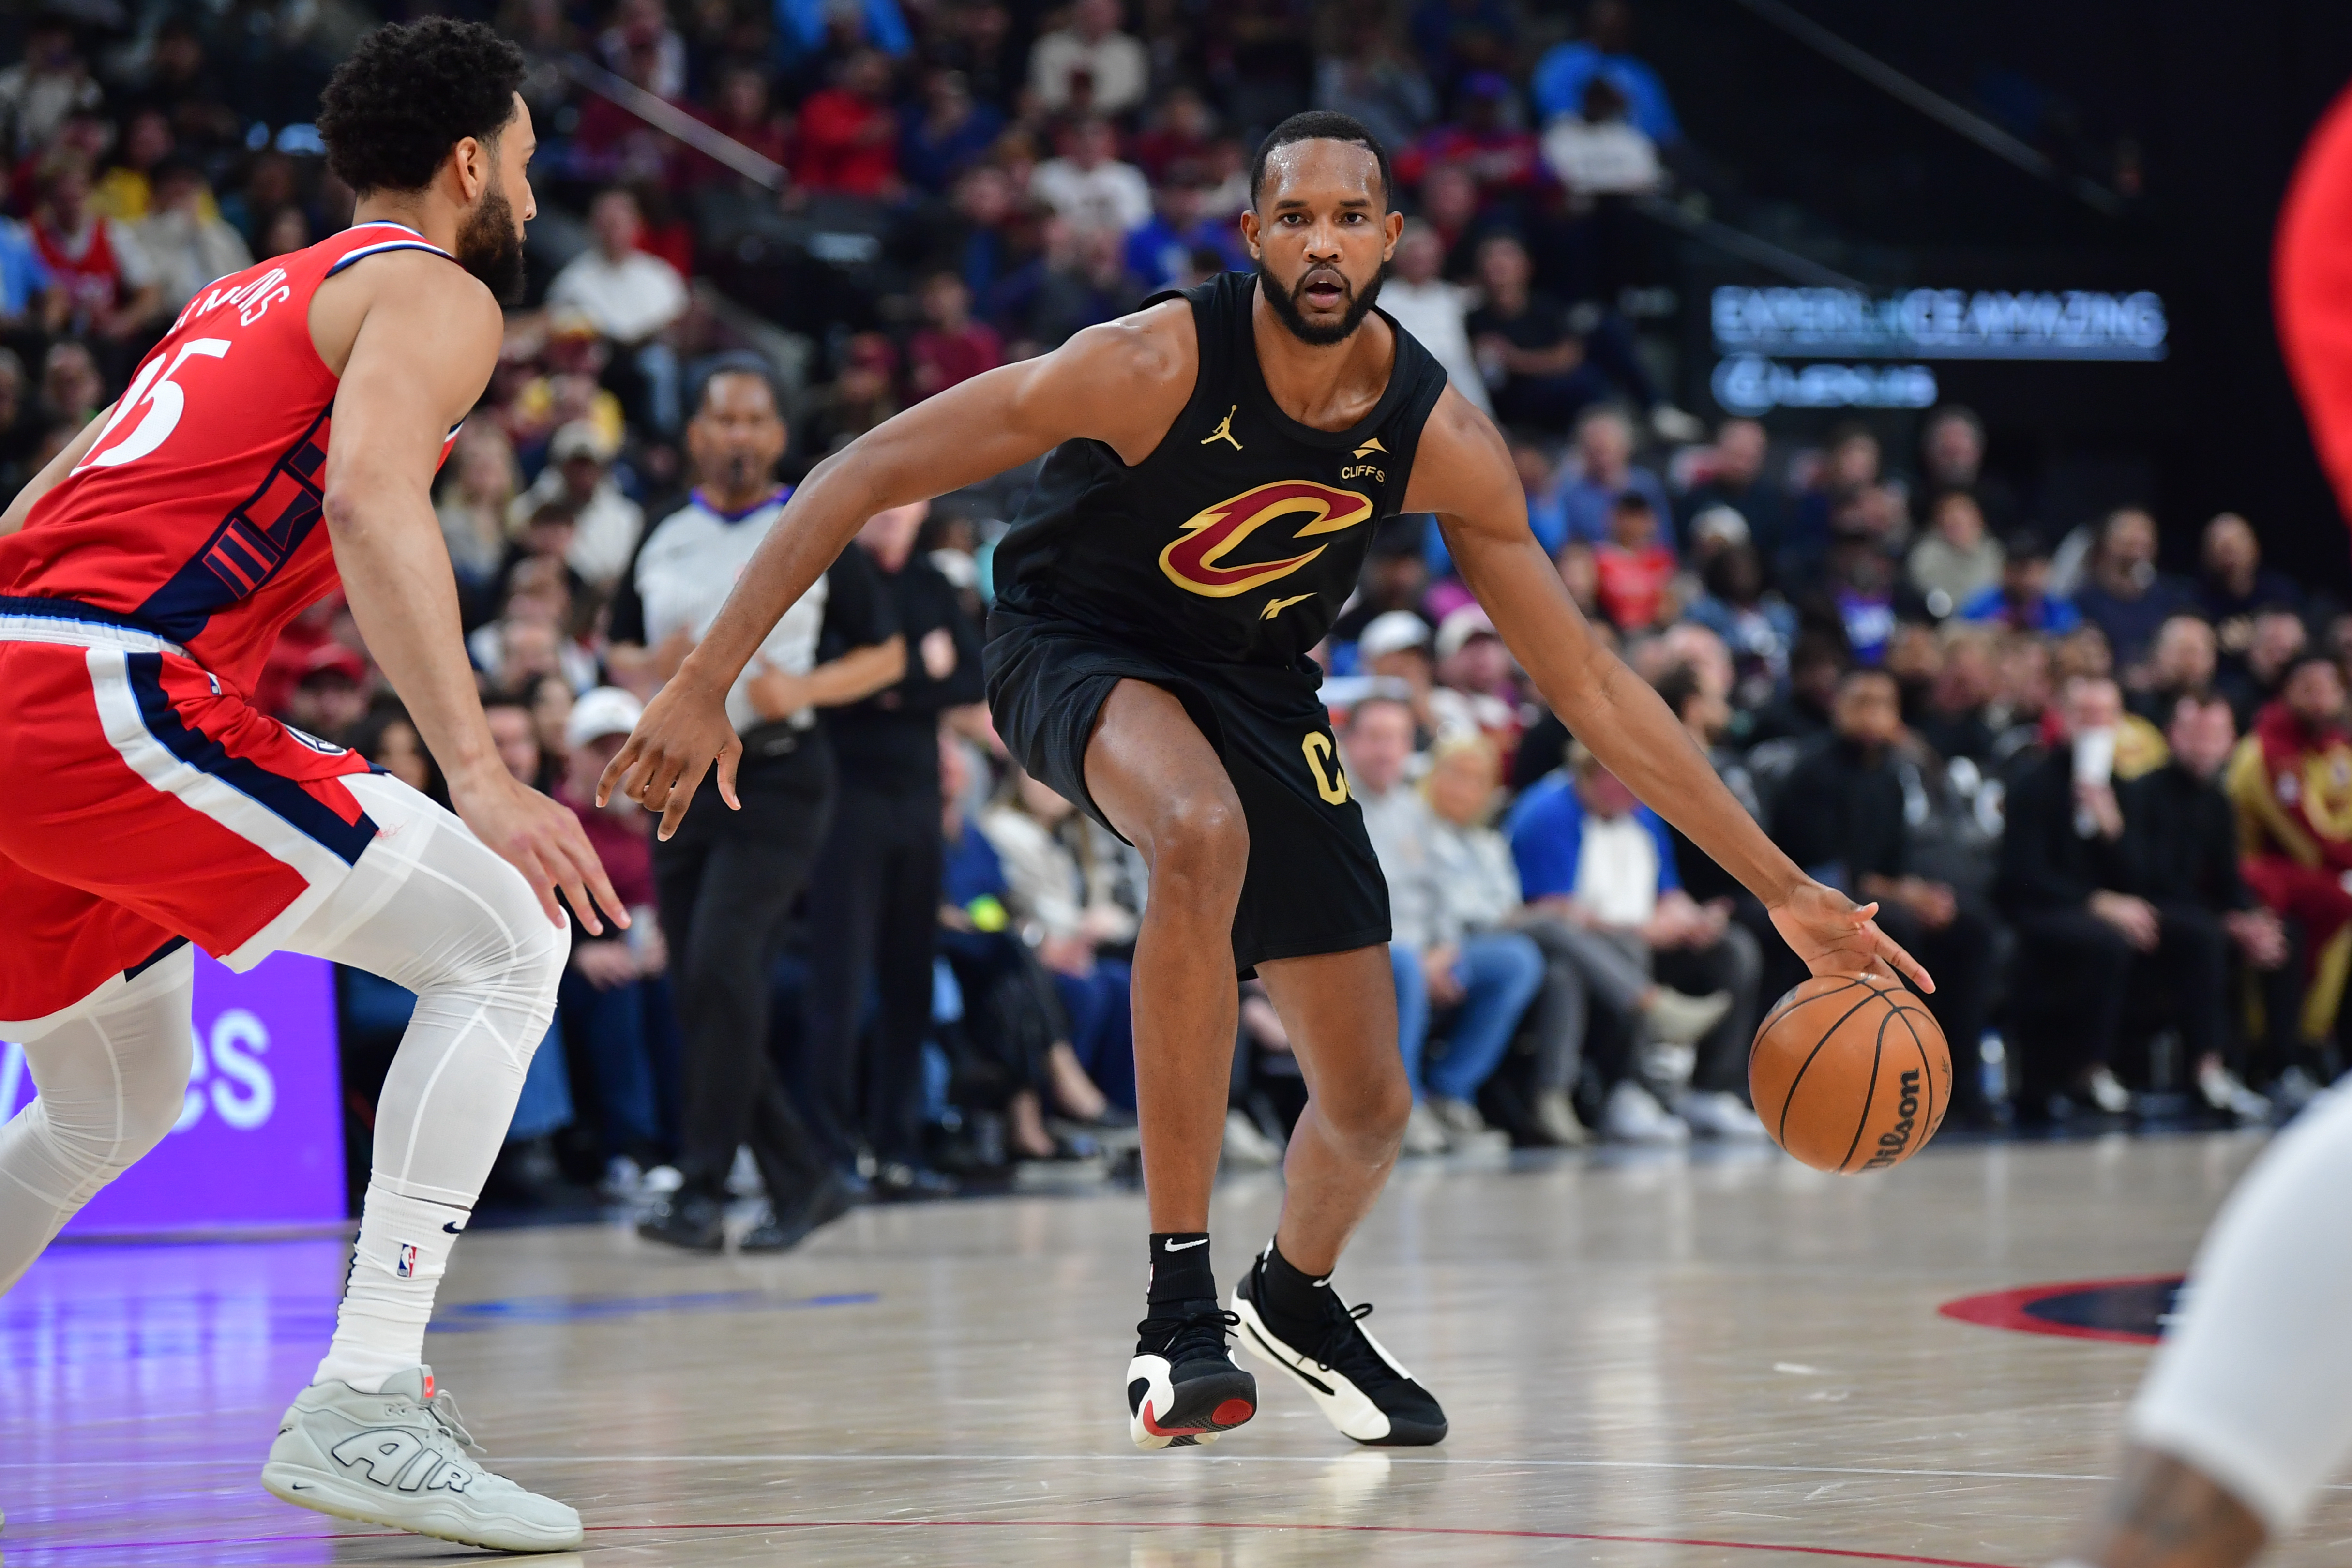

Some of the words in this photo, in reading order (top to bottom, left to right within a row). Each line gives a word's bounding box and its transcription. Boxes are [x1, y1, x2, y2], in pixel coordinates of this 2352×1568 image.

[166, 268, 290, 333] MONS
[1341, 465, 1386, 483] CLIFFS
[1301, 726, 1355, 806] C
[331, 1427, 473, 1492] AIR
